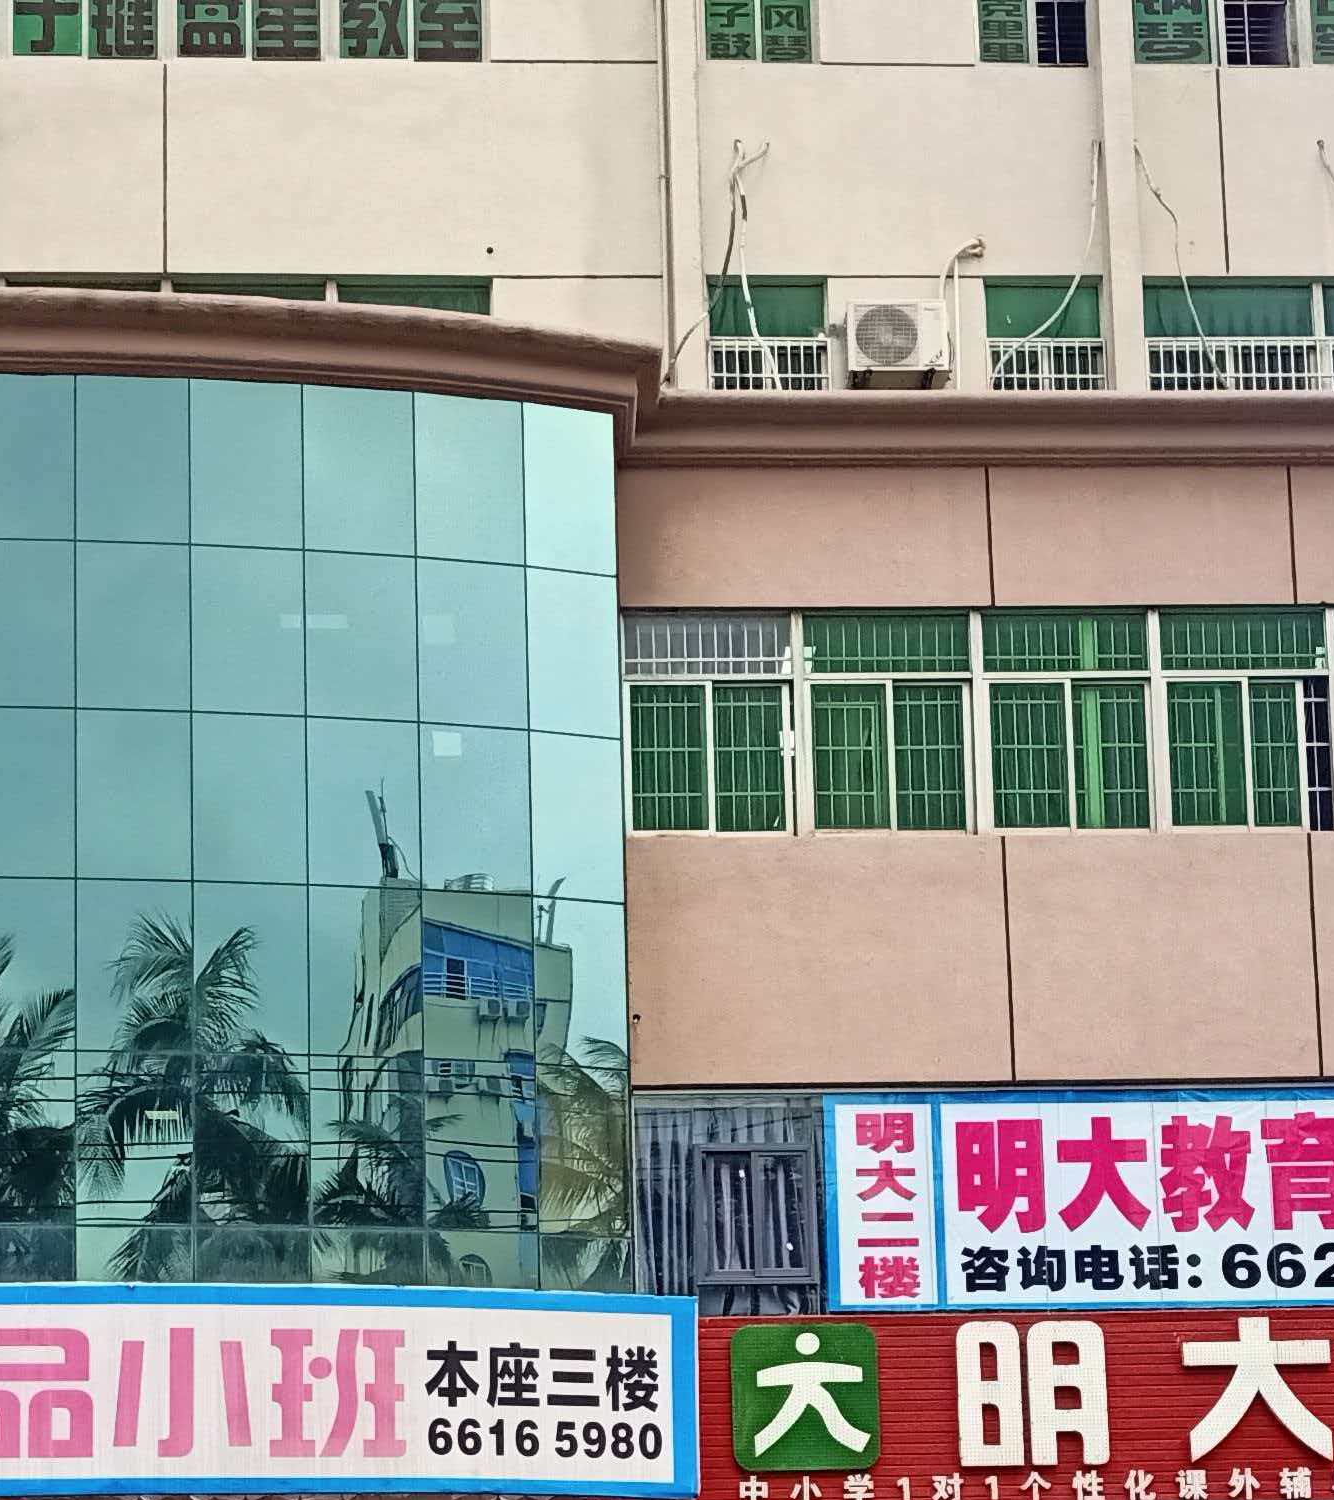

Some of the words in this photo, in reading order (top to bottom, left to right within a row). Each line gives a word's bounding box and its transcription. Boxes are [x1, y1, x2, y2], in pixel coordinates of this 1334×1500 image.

[855, 1112, 921, 1300] 明大二楼
[424, 1341, 660, 1413] 本座三楼
[427, 1418, 540, 1457] 6616
[554, 1422, 663, 1461] 5980
